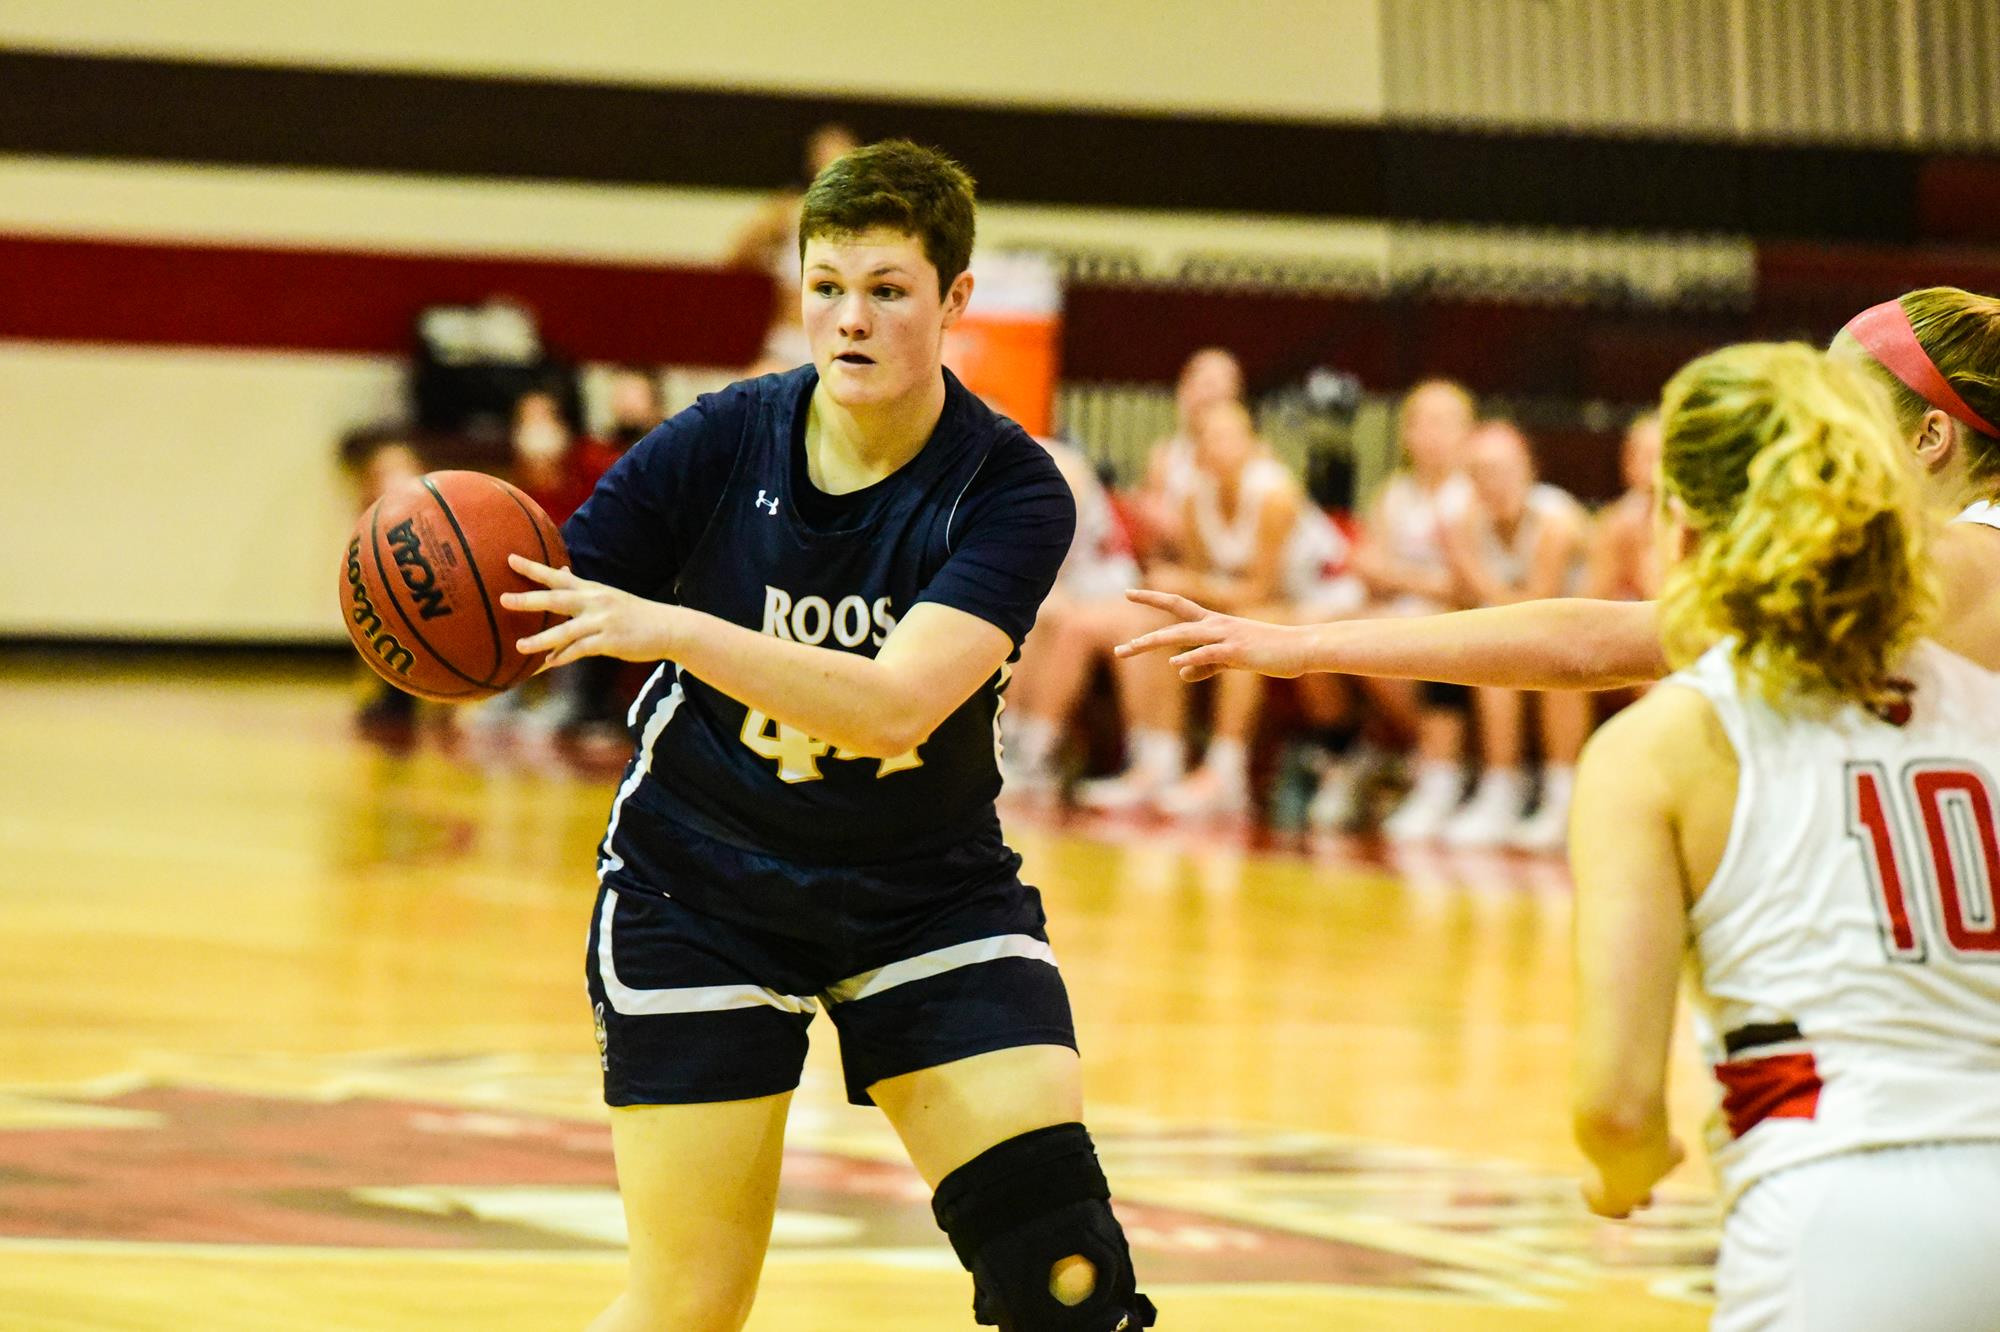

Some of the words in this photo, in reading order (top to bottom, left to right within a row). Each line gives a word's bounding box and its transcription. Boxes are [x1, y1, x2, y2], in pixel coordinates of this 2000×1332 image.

[347, 534, 416, 676] Wilson
[387, 518, 453, 621] NCAA
[761, 584, 898, 648] ROOS
[740, 706, 924, 784] 4
[1844, 758, 2000, 965] 10
